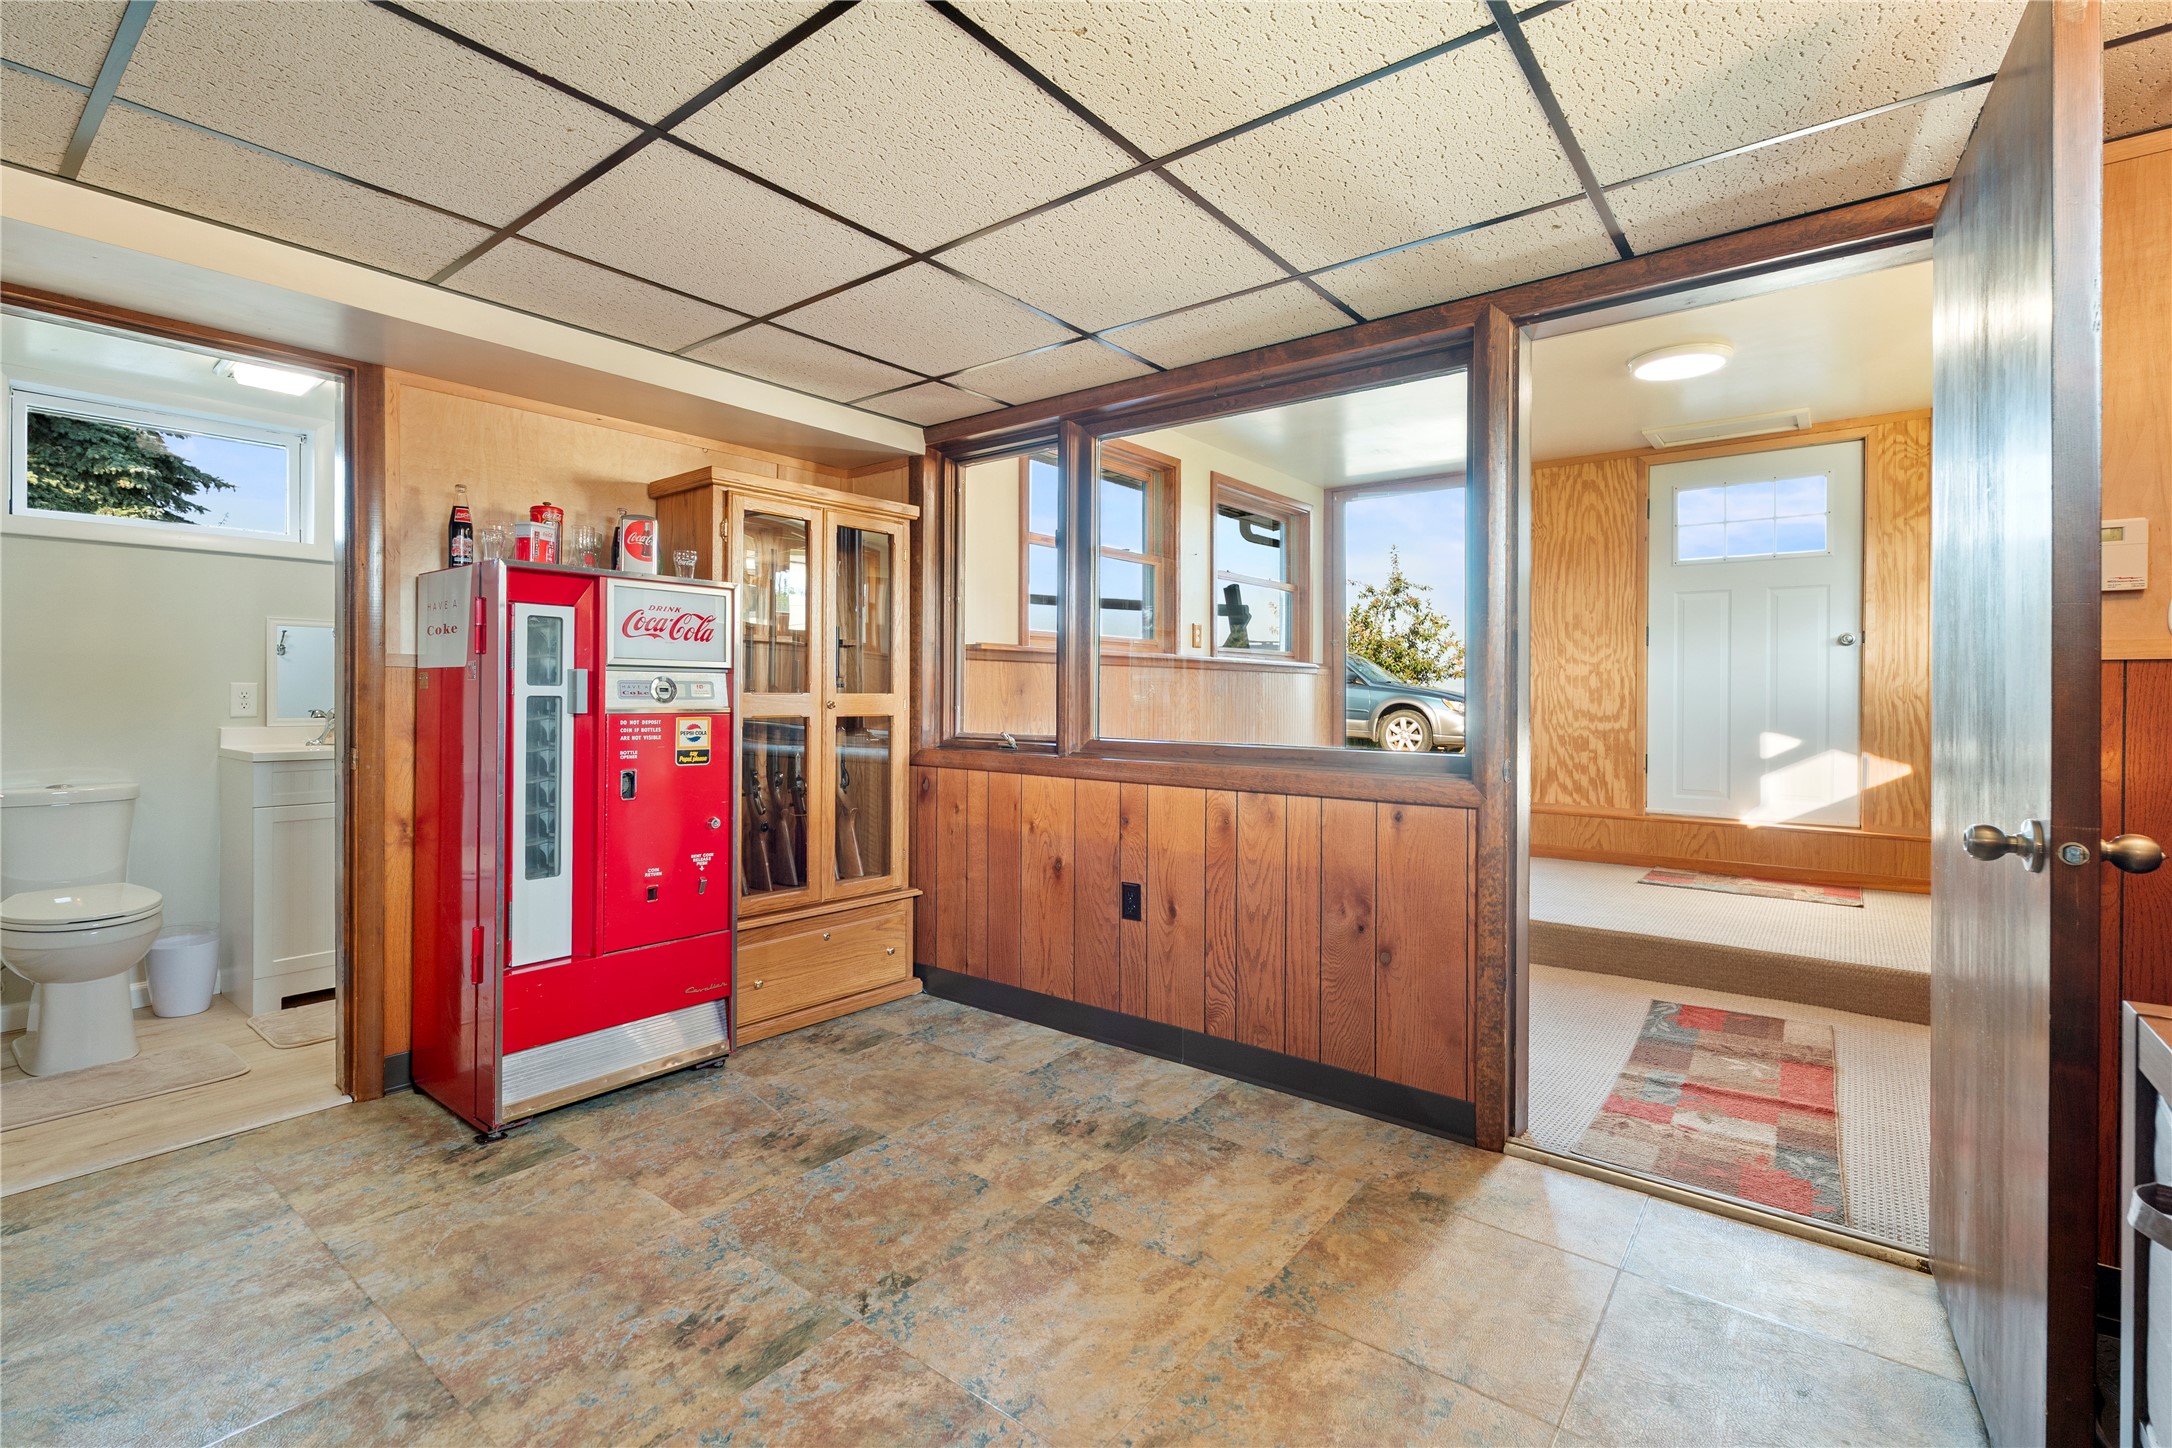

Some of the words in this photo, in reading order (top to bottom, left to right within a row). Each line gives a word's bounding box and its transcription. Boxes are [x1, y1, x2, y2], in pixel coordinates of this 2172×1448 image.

[427, 600, 448, 611] HAVE
[452, 599, 458, 609] A
[648, 605, 682, 613] DRINK
[427, 623, 458, 637] Coke
[621, 609, 716, 643] Coca-Cola
